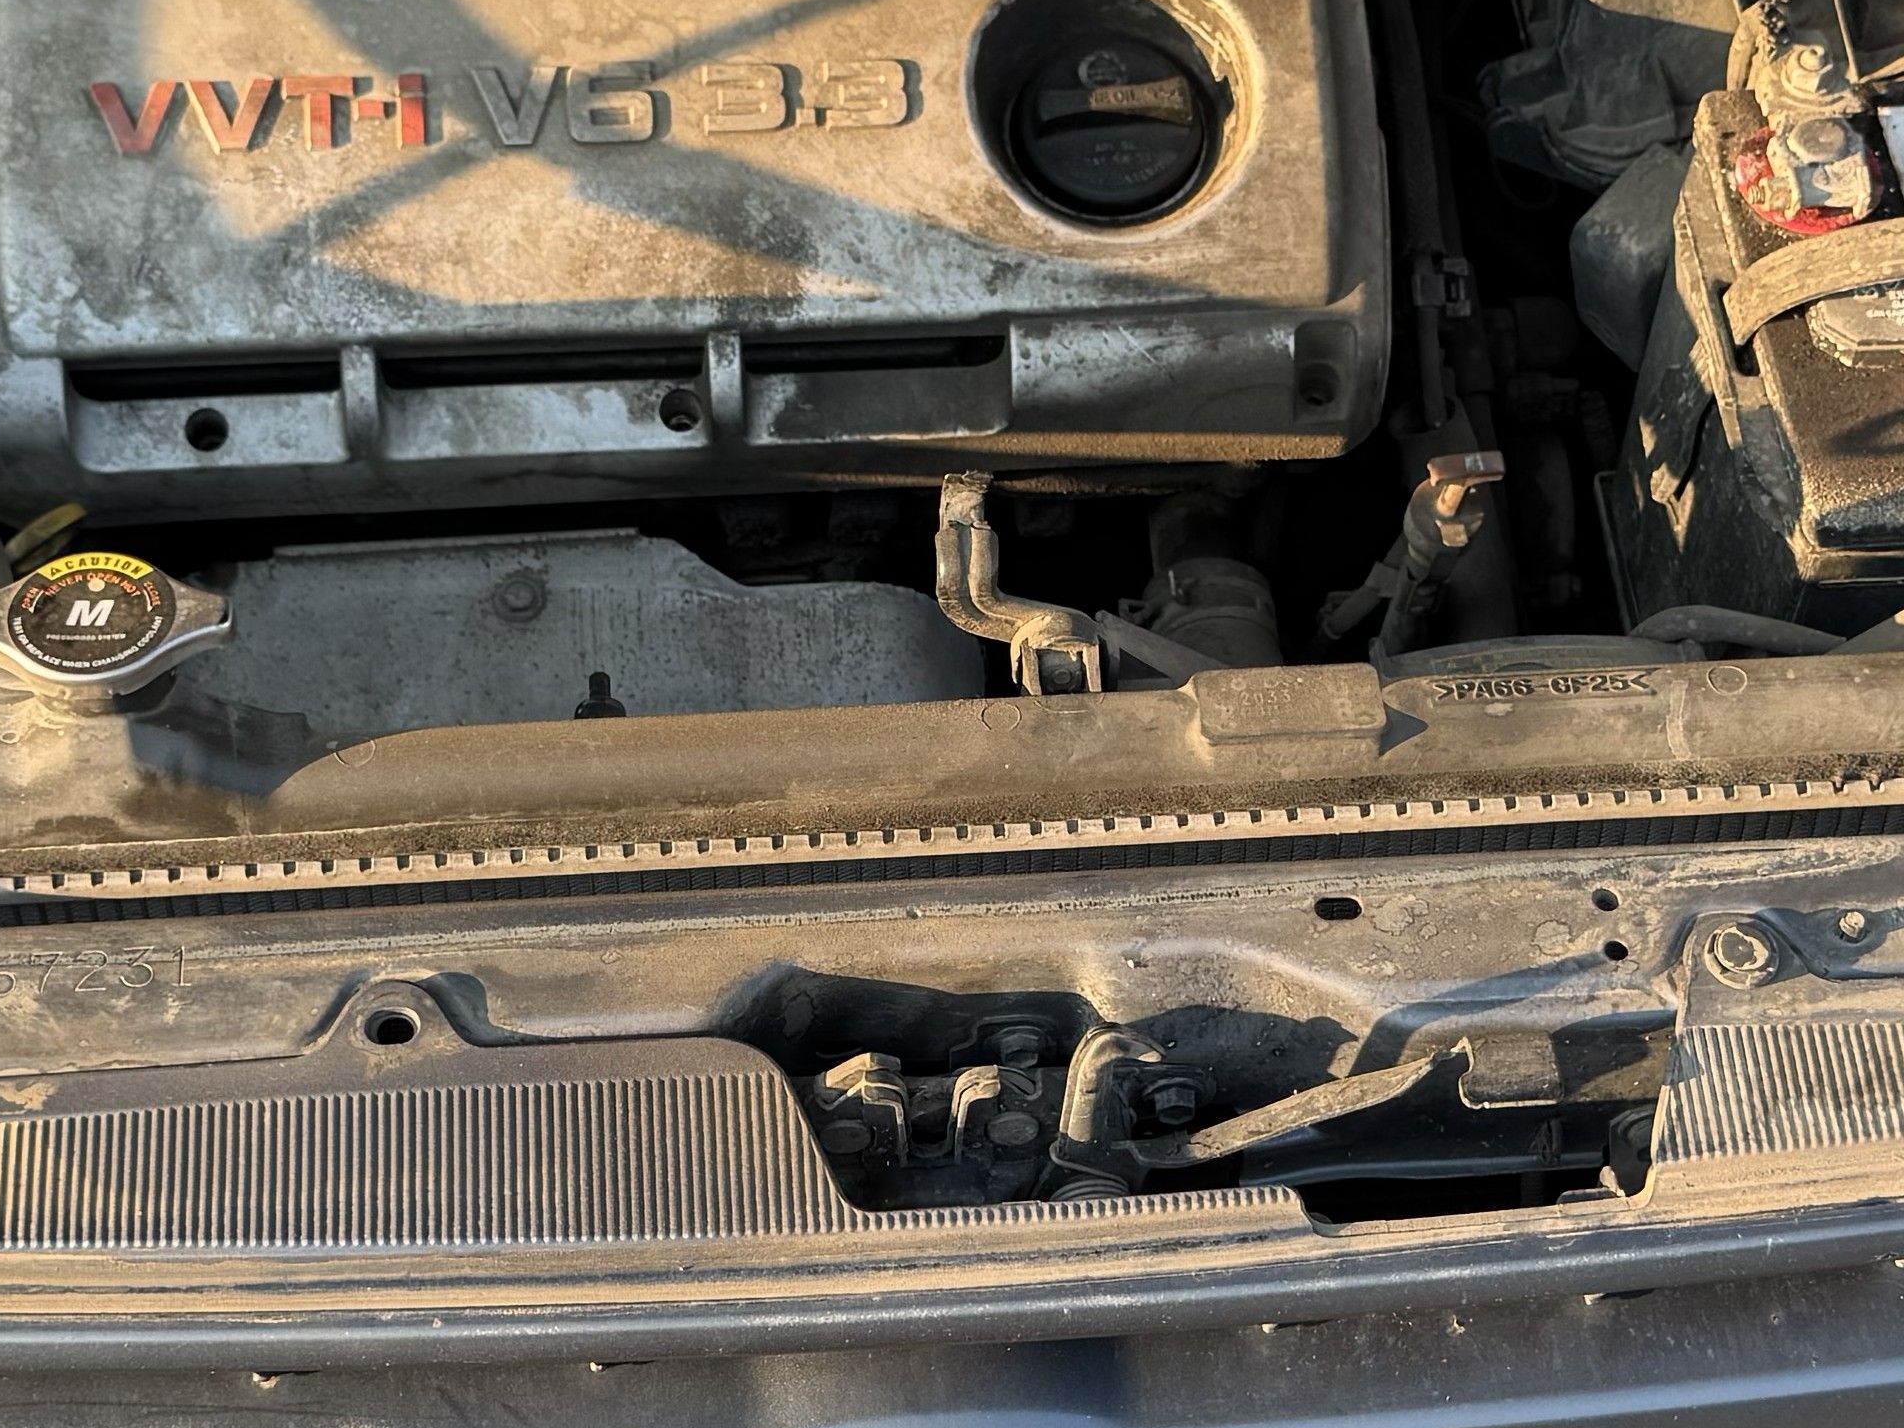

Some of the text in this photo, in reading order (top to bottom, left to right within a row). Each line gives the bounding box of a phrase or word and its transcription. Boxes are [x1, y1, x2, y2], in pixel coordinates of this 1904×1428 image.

[471, 61, 664, 149] V6
[699, 57, 914, 133] 3.3
[64, 556, 144, 576] CAUTION
[44, 573, 84, 597] NEVER
[86, 571, 121, 585] OPEN
[120, 579, 142, 598] HOT
[65, 599, 116, 627] M
[26, 643, 60, 667] REPLACE
